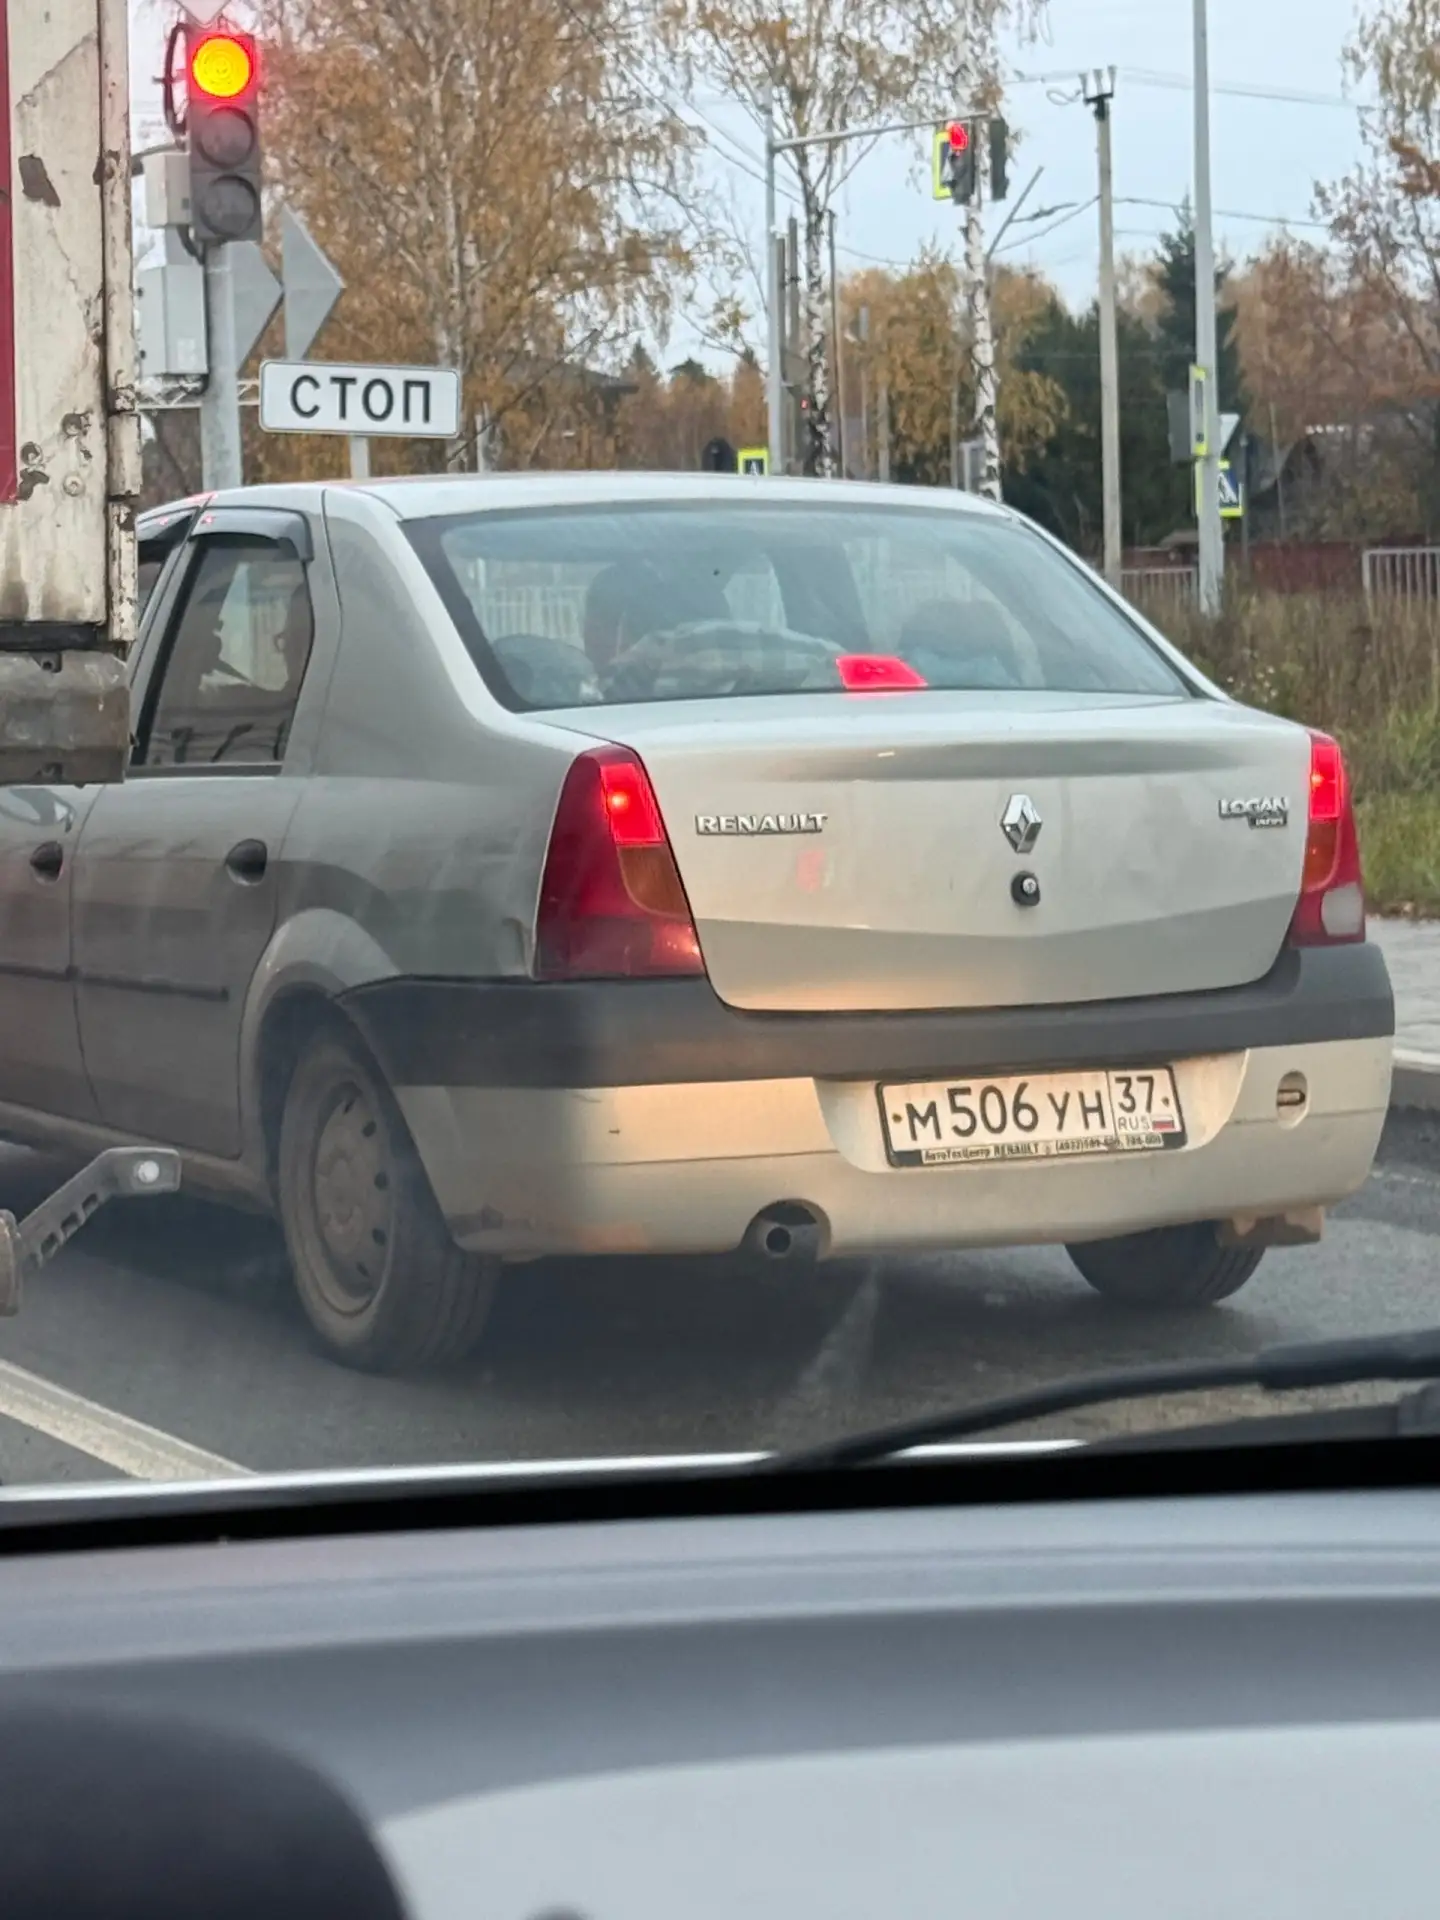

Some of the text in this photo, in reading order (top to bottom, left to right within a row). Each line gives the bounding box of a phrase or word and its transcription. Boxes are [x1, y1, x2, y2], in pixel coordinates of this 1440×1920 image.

[290, 375, 431, 424] СТОП
[1218, 797, 1290, 819] LOGAN
[695, 813, 828, 836] RENAULT
[1114, 1075, 1155, 1114] 37
[1117, 1115, 1150, 1131] RUS
